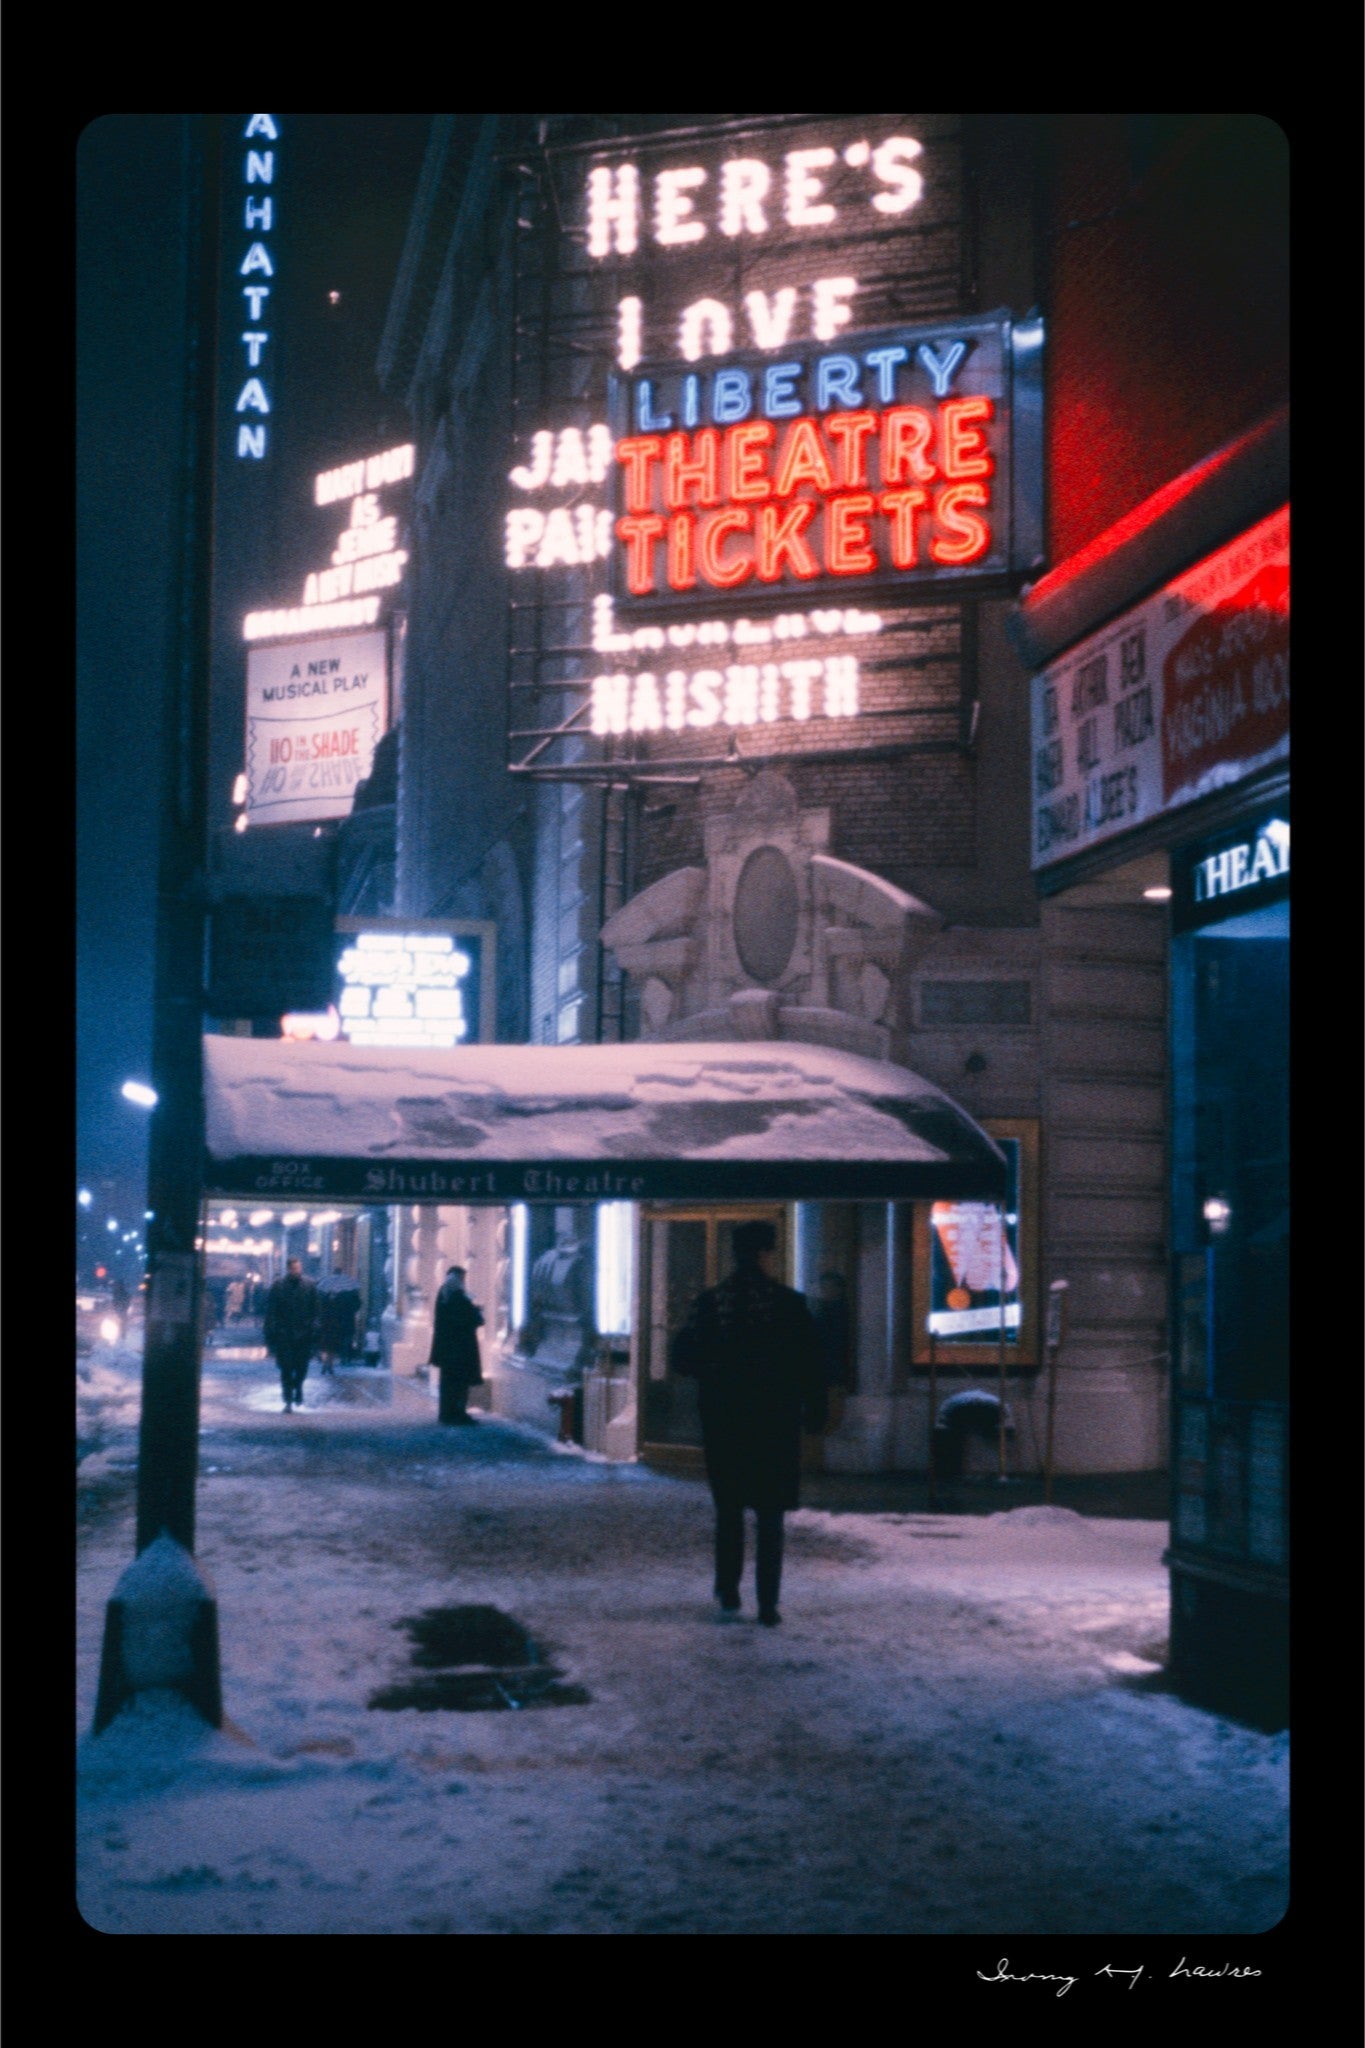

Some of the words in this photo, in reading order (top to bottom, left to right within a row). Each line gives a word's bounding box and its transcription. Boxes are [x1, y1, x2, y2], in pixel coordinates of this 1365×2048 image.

[586, 137, 923, 257] HERE'S
[638, 341, 968, 432] LIBERTY
[614, 396, 993, 513] THEATRE
[615, 484, 991, 595] TICKETS
[290, 664, 301, 677] A
[307, 659, 341, 676] NEW
[262, 681, 328, 701] MUSICAL
[333, 674, 368, 692] PLAY
[590, 654, 862, 735] NAISMITH
[311, 728, 359, 759] SHADE
[254, 1175, 326, 1190] OFFICE
[271, 1160, 311, 1175] BOX
[363, 1167, 497, 1194] Shubert
[523, 1169, 646, 1194] Theatre
